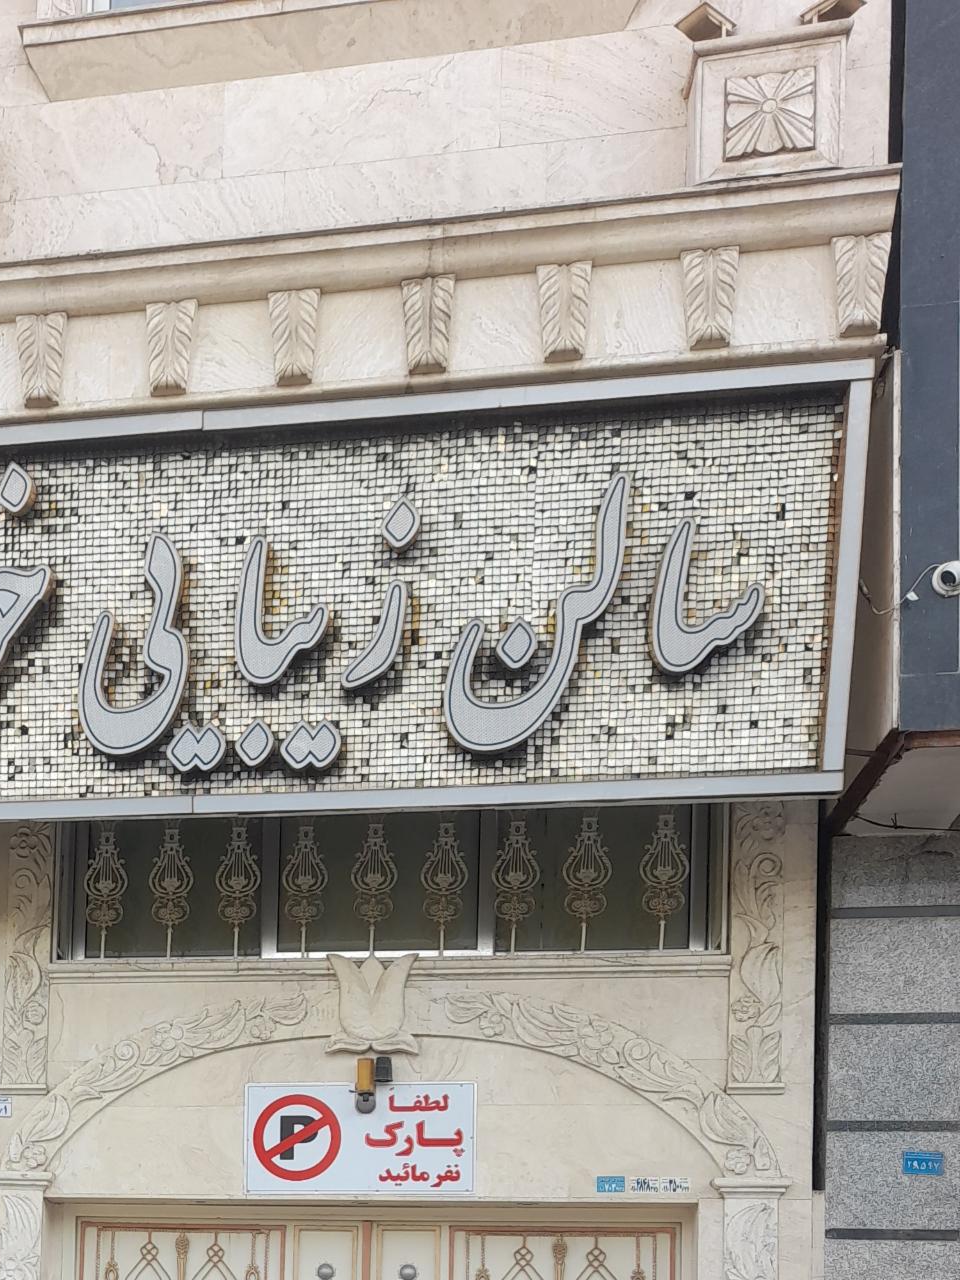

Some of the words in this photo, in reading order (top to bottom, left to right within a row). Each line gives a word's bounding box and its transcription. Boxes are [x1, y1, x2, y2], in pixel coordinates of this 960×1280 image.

[77, 497, 422, 772] زیبایی
[444, 470, 767, 754] سالن
[364, 1120, 465, 1157] پارک
